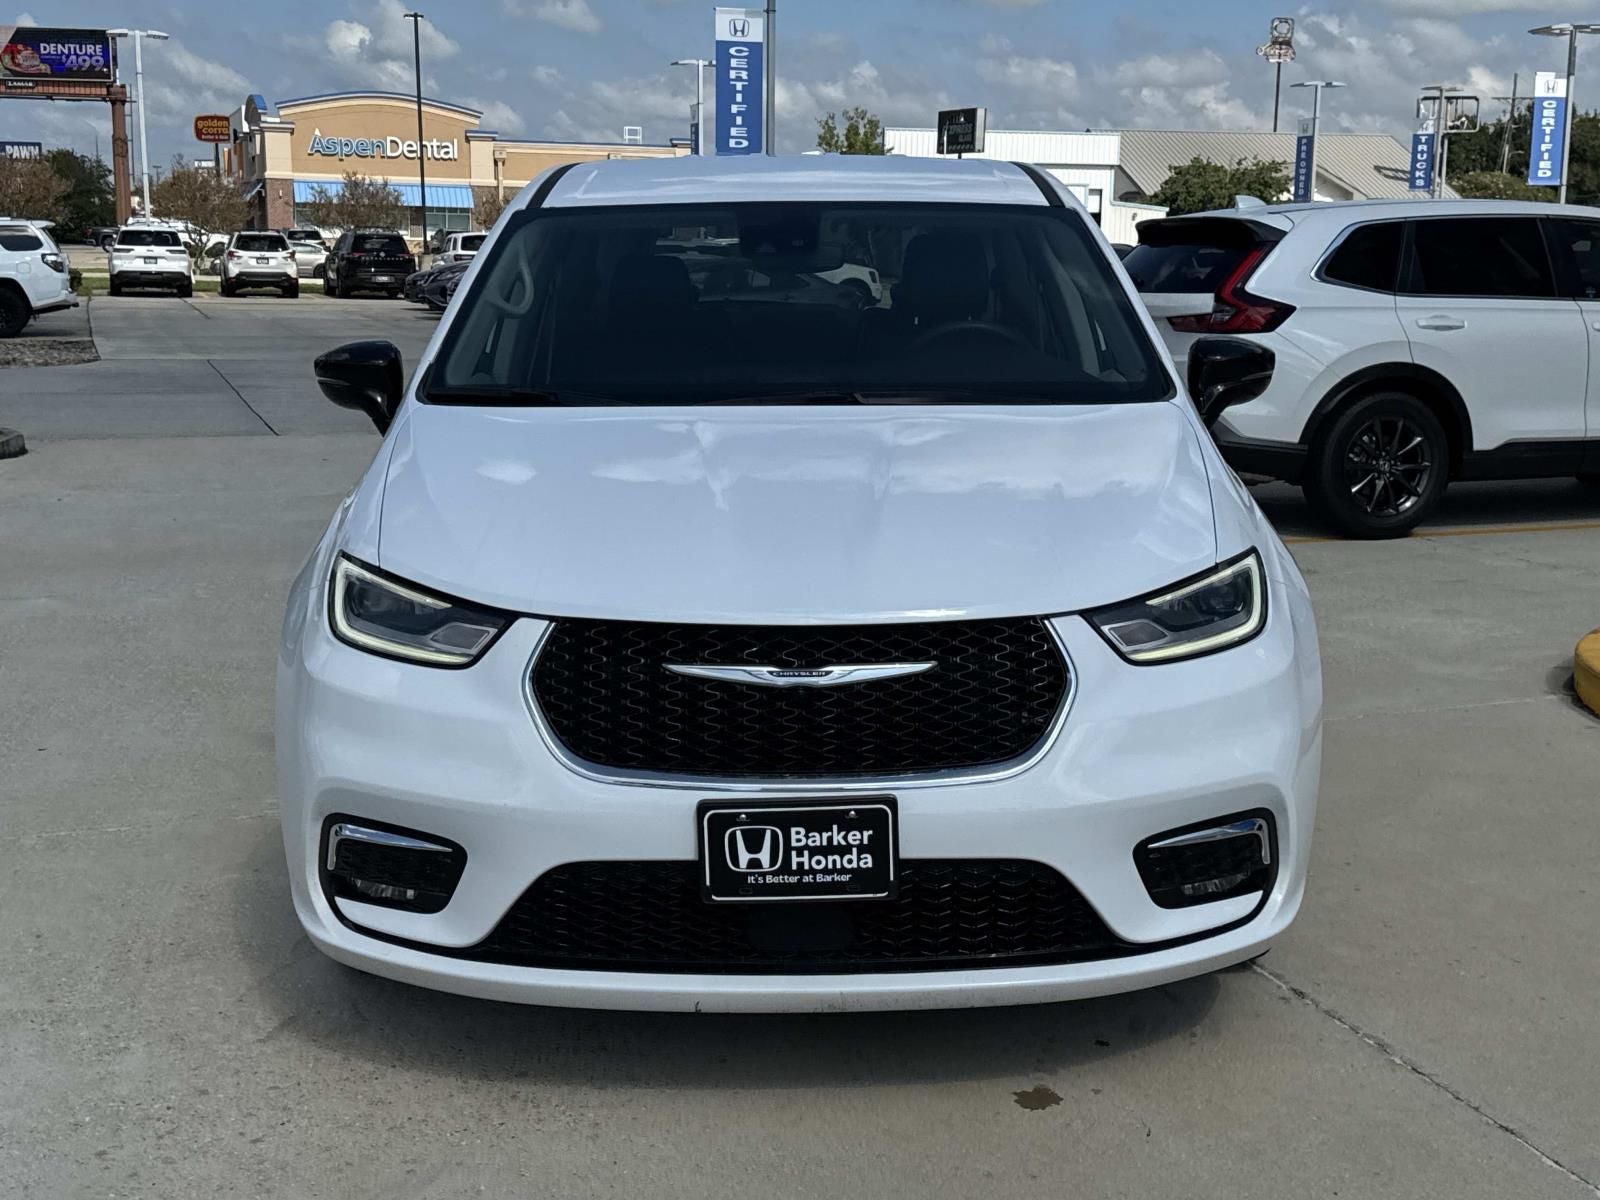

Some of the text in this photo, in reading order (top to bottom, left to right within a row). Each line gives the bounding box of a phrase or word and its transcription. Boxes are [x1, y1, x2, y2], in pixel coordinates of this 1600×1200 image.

[40, 43, 102, 55] DENTURE
[729, 46, 750, 148] CERTIFIED
[197, 119, 228, 129] golden
[1538, 100, 1557, 178] CERTIFIED
[5, 145, 40, 159] PAWN
[1415, 135, 1428, 186] TRUCKS
[1299, 160, 1307, 195] OWNED
[790, 825, 873, 847] Barker
[791, 848, 873, 870] Honda
[747, 873, 852, 884] It's Better at Barker
